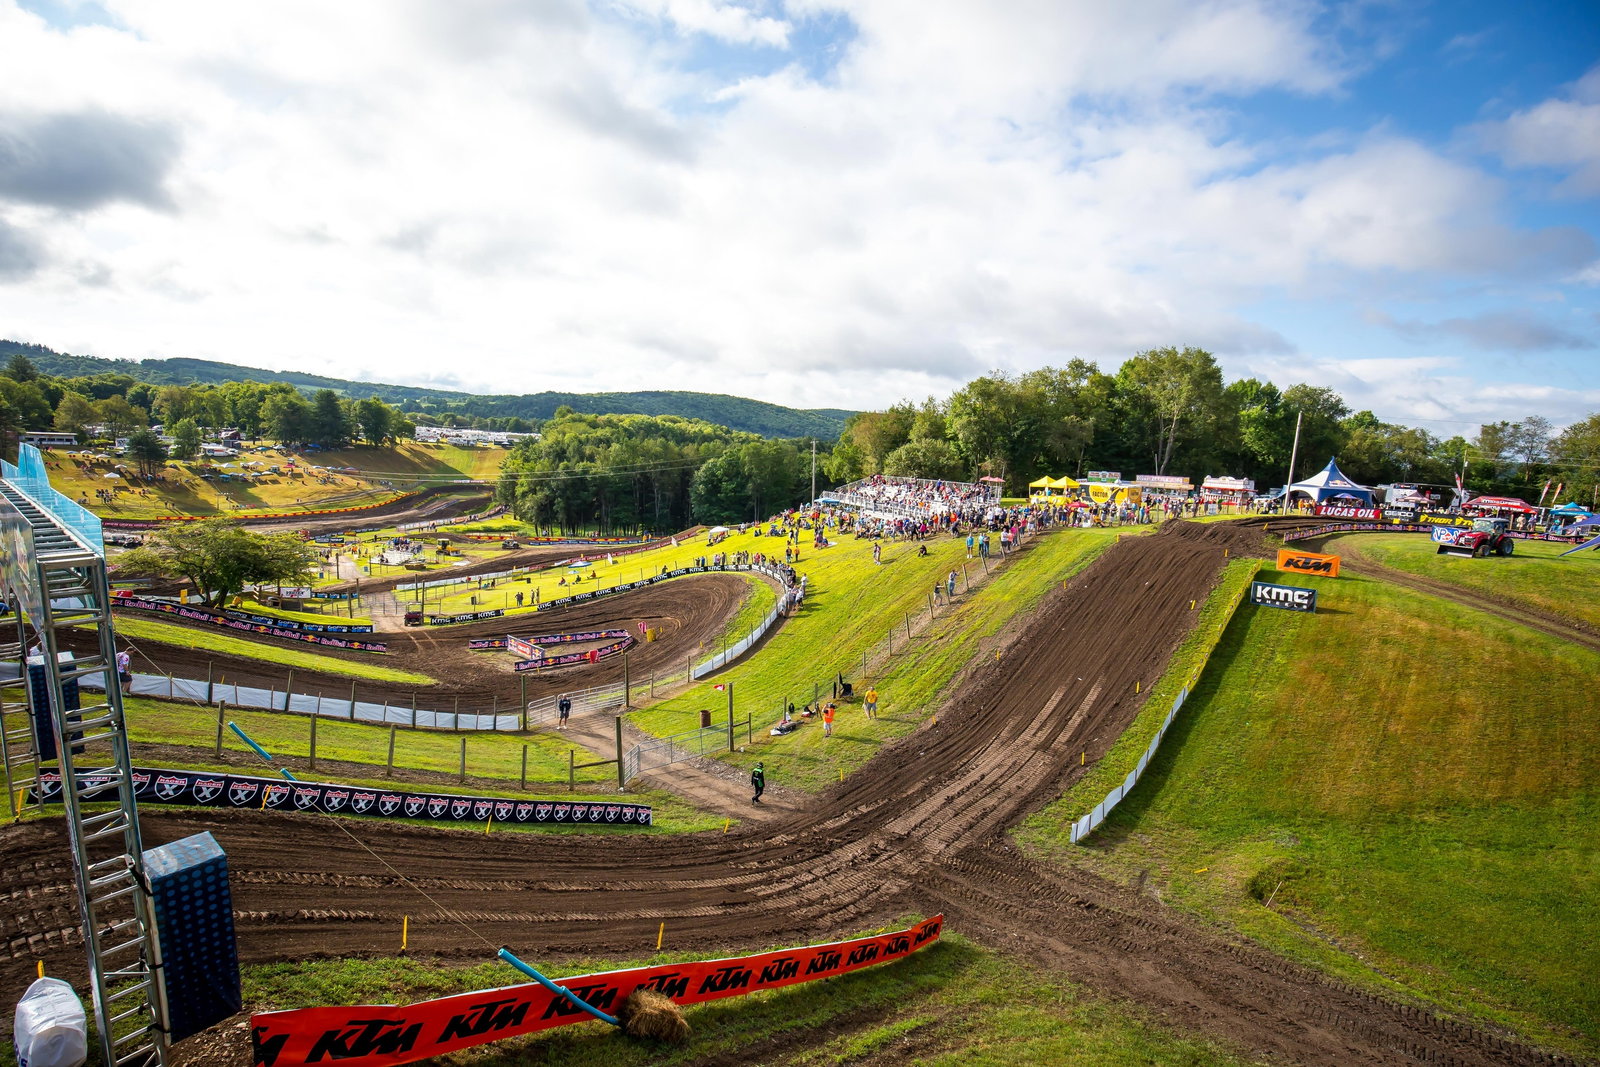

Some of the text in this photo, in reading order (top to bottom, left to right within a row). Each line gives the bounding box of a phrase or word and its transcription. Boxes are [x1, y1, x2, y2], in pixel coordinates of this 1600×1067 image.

[1320, 507, 1375, 518] LUCAS OIL
[1427, 516, 1453, 525] THOR
[1283, 556, 1333, 573] KTM
[1256, 585, 1309, 604] KMC
[160, 783, 178, 795] X
[198, 786, 215, 798] X
[233, 789, 249, 800] X
[267, 792, 281, 803] X
[298, 795, 312, 805] X
[328, 797, 341, 807] X
[355, 799, 368, 809] X
[382, 801, 395, 811] X
[408, 803, 419, 812] X
[432, 804, 442, 814] X
[454, 806, 465, 815] X
[477, 807, 488, 816] X
[498, 808, 508, 817] X
[519, 809, 529, 817] X
[538, 809, 548, 817] X
[557, 810, 566, 818] X
[575, 810, 584, 818] X
[608, 811, 617, 819] X
[304, 1019, 424, 1063] KTM
[436, 998, 532, 1044] KTM
[697, 966, 752, 994] KTM
[757, 957, 800, 984] KTM
[805, 950, 842, 975] KTM
[846, 943, 880, 966] KTM
[883, 936, 910, 956] KTM
[913, 922, 939, 946] KTM
